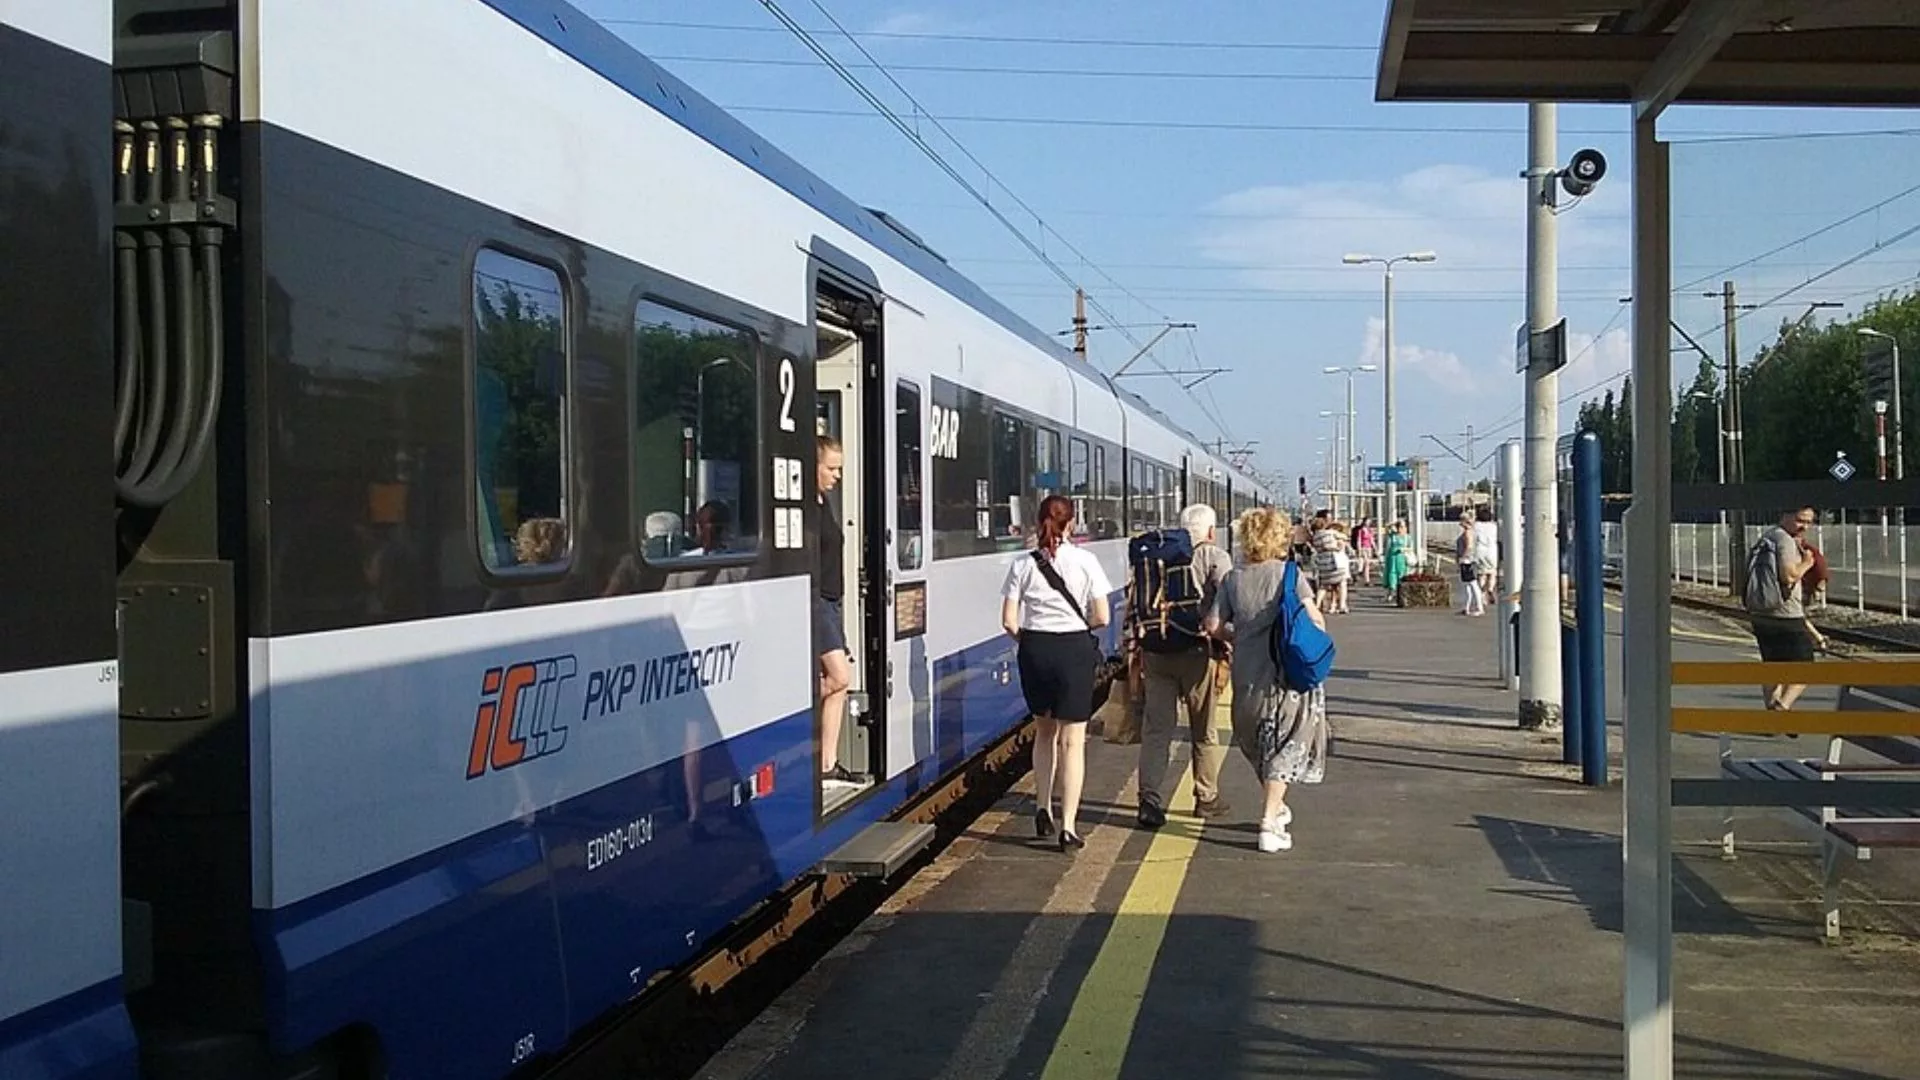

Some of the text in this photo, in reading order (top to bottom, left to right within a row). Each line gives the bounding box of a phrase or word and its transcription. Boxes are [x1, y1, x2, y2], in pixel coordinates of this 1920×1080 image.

[779, 358, 797, 433] 2
[931, 404, 960, 460] BAR
[582, 641, 741, 721] PKP INTERCITY
